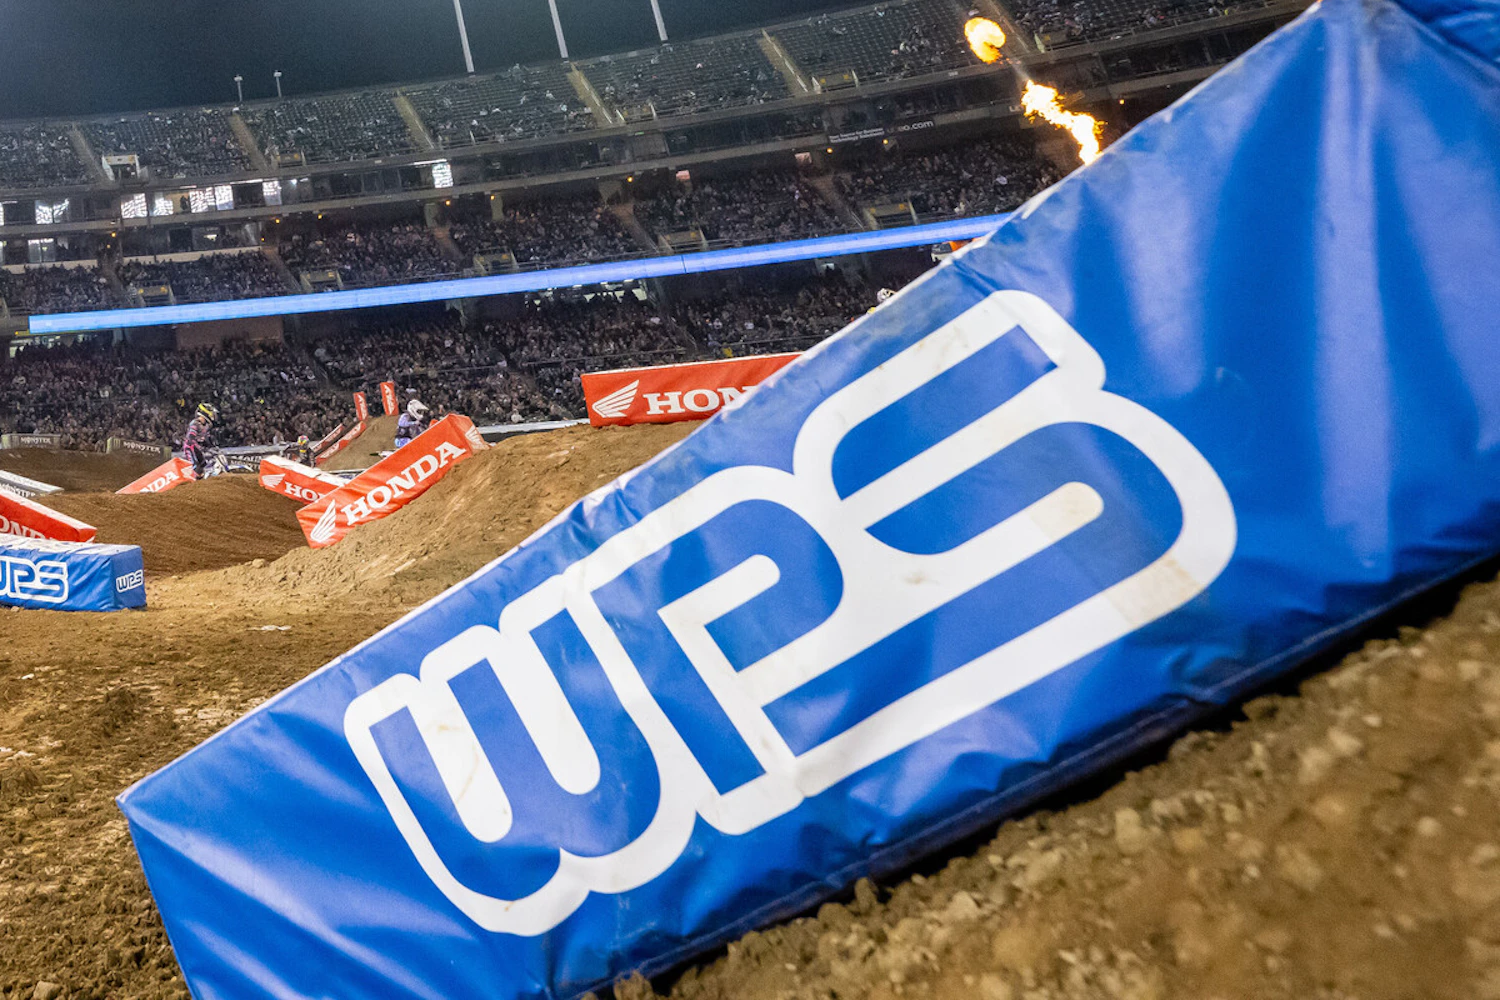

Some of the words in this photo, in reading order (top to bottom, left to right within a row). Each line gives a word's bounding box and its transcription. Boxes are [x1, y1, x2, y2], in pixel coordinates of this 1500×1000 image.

[341, 441, 467, 526] HONDA
[115, 568, 144, 592] WPS
[343, 289, 1238, 936] WPS
